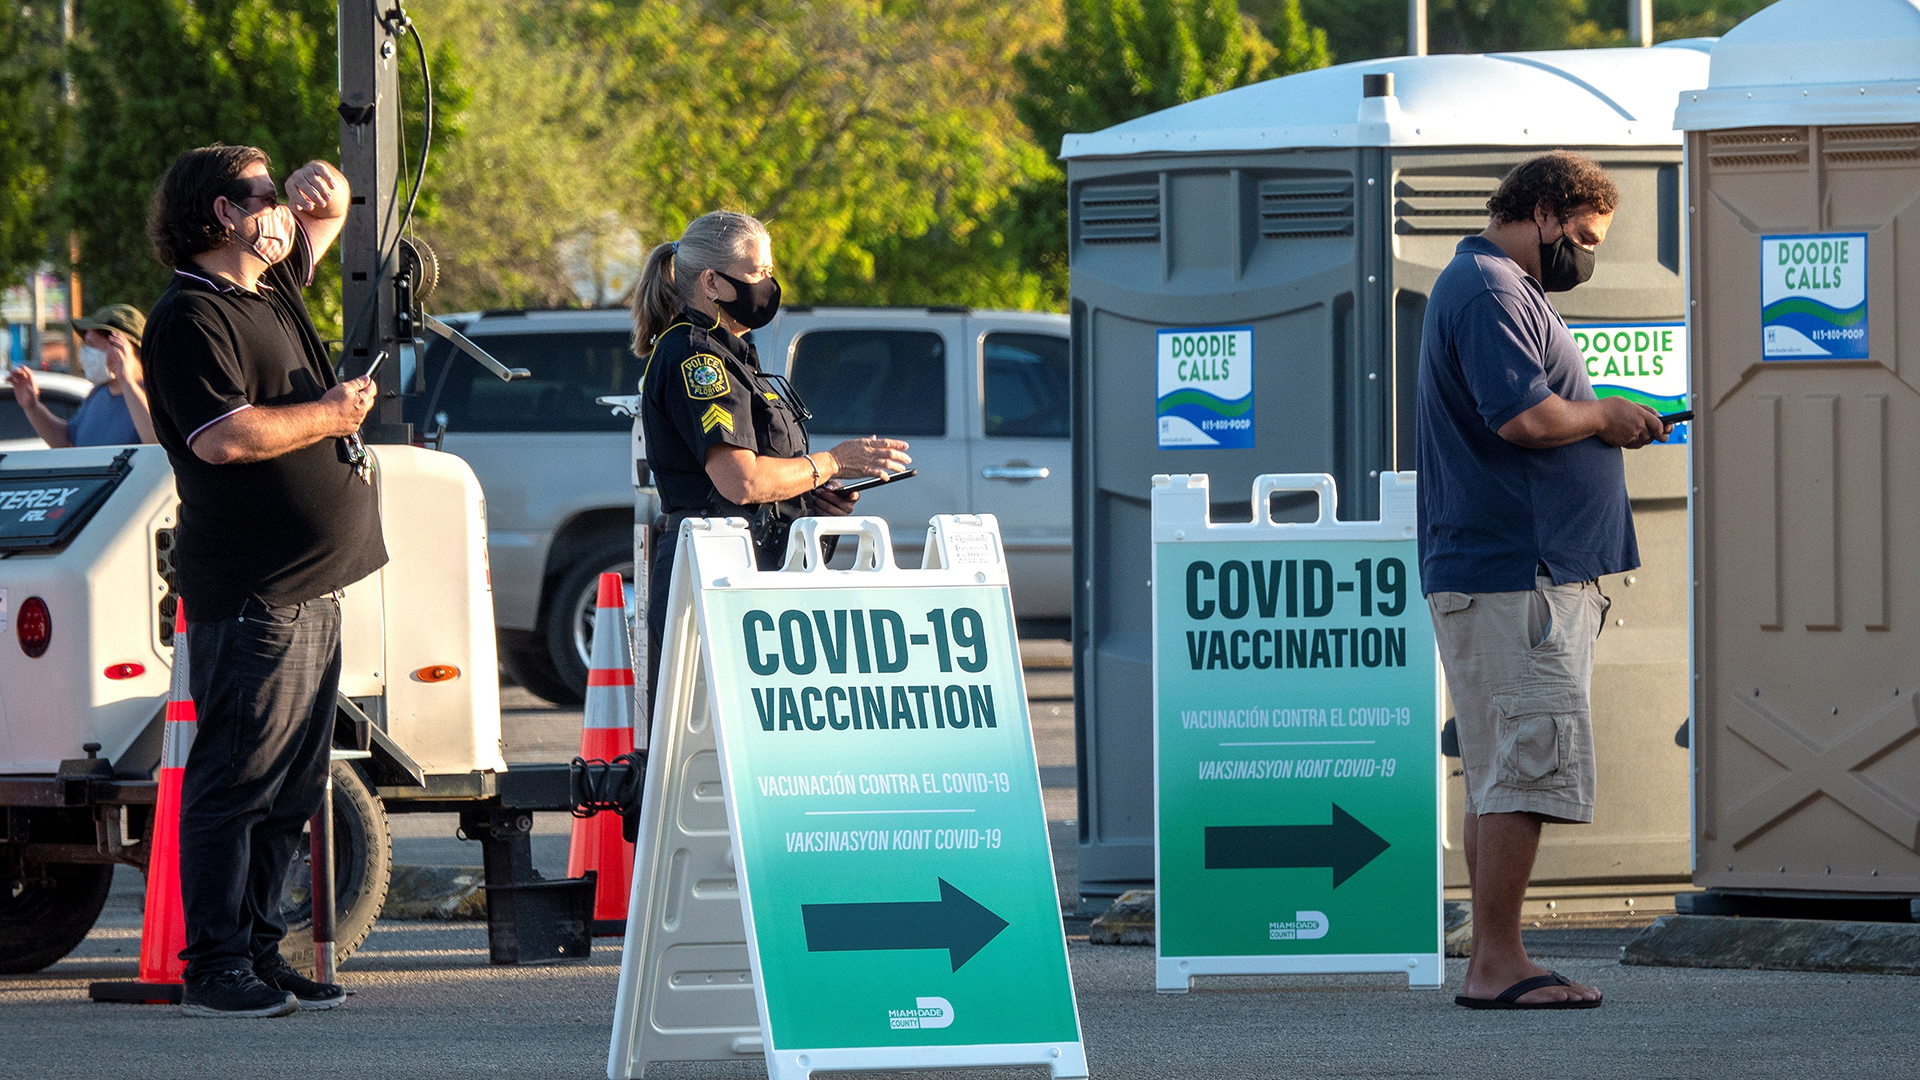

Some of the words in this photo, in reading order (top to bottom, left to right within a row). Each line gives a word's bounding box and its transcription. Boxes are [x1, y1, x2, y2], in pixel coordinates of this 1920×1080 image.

[1779, 241, 1849, 266] DOODIE
[1785, 266, 1841, 290] CALLS
[1172, 334, 1236, 358] DOODIE
[1573, 330, 1673, 353] DOODIE
[685, 356, 720, 371] POLICE
[1178, 359, 1229, 381] CALLS
[1585, 354, 1664, 377] CALLS
[0, 487, 80, 510] TEREX
[1186, 557, 1407, 620] COVID-19
[742, 607, 988, 676] COVID-19
[1186, 627, 1407, 670] VACCINATION
[750, 684, 997, 732] VACCINATION
[1181, 705, 1269, 729] VACUNACIÓN
[1272, 708, 1328, 728] CONTRA
[1330, 708, 1347, 727] EL
[1349, 706, 1411, 727] COVID-19
[1198, 760, 1294, 780] VAKSINASYON
[1294, 759, 1333, 779] KONT
[1333, 758, 1397, 778] COVID-19
[757, 771, 857, 797] VACUNACIÓN
[858, 773, 921, 795] CONTRA
[922, 773, 941, 794] EL
[942, 772, 1011, 794] COVID-19
[785, 830, 889, 853] VAKSINASYON
[892, 829, 932, 851] KONT
[934, 828, 1002, 850] COVID-19
[888, 1009, 942, 1018] MIAMI-DADE
